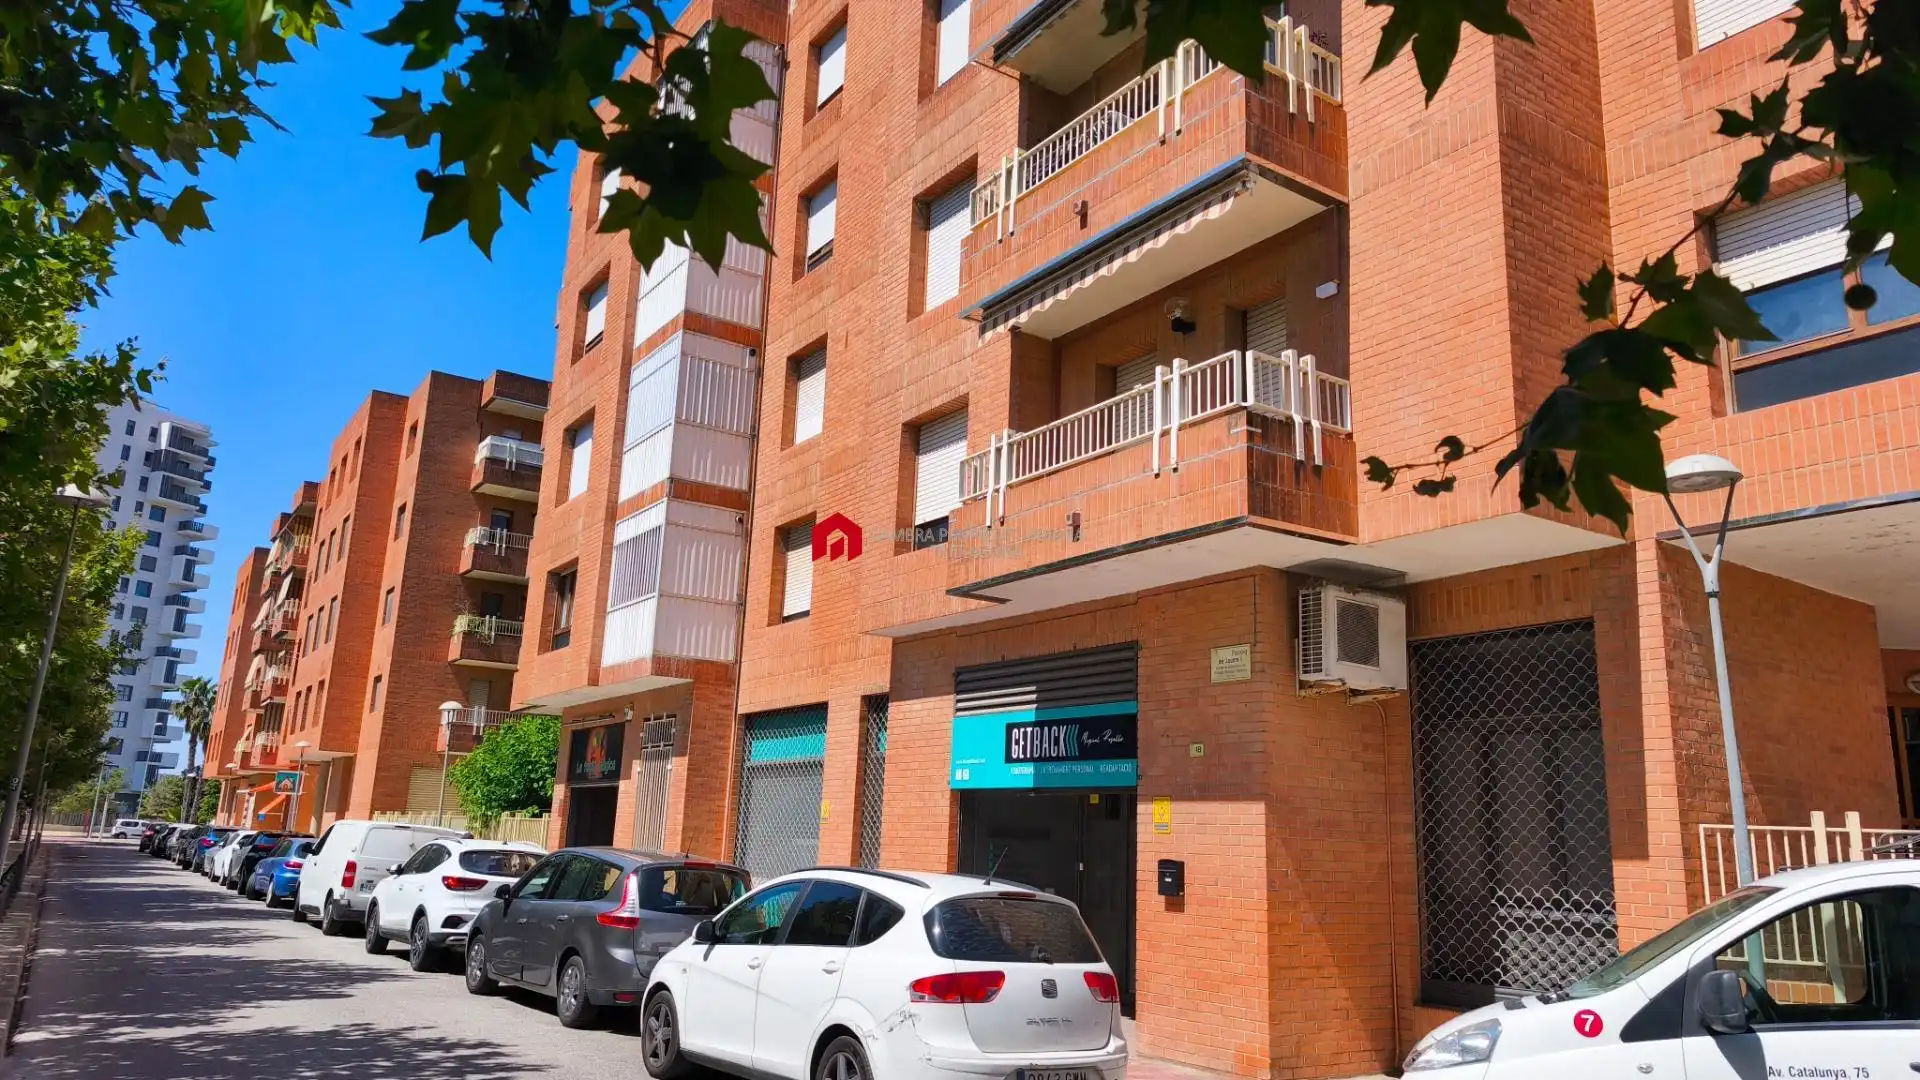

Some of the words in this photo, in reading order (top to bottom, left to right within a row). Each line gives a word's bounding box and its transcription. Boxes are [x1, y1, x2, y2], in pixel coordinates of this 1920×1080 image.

[1011, 725, 1067, 759] GETBACK
[1580, 1014, 1595, 1033] 7
[1853, 1066, 1870, 1079] 75
